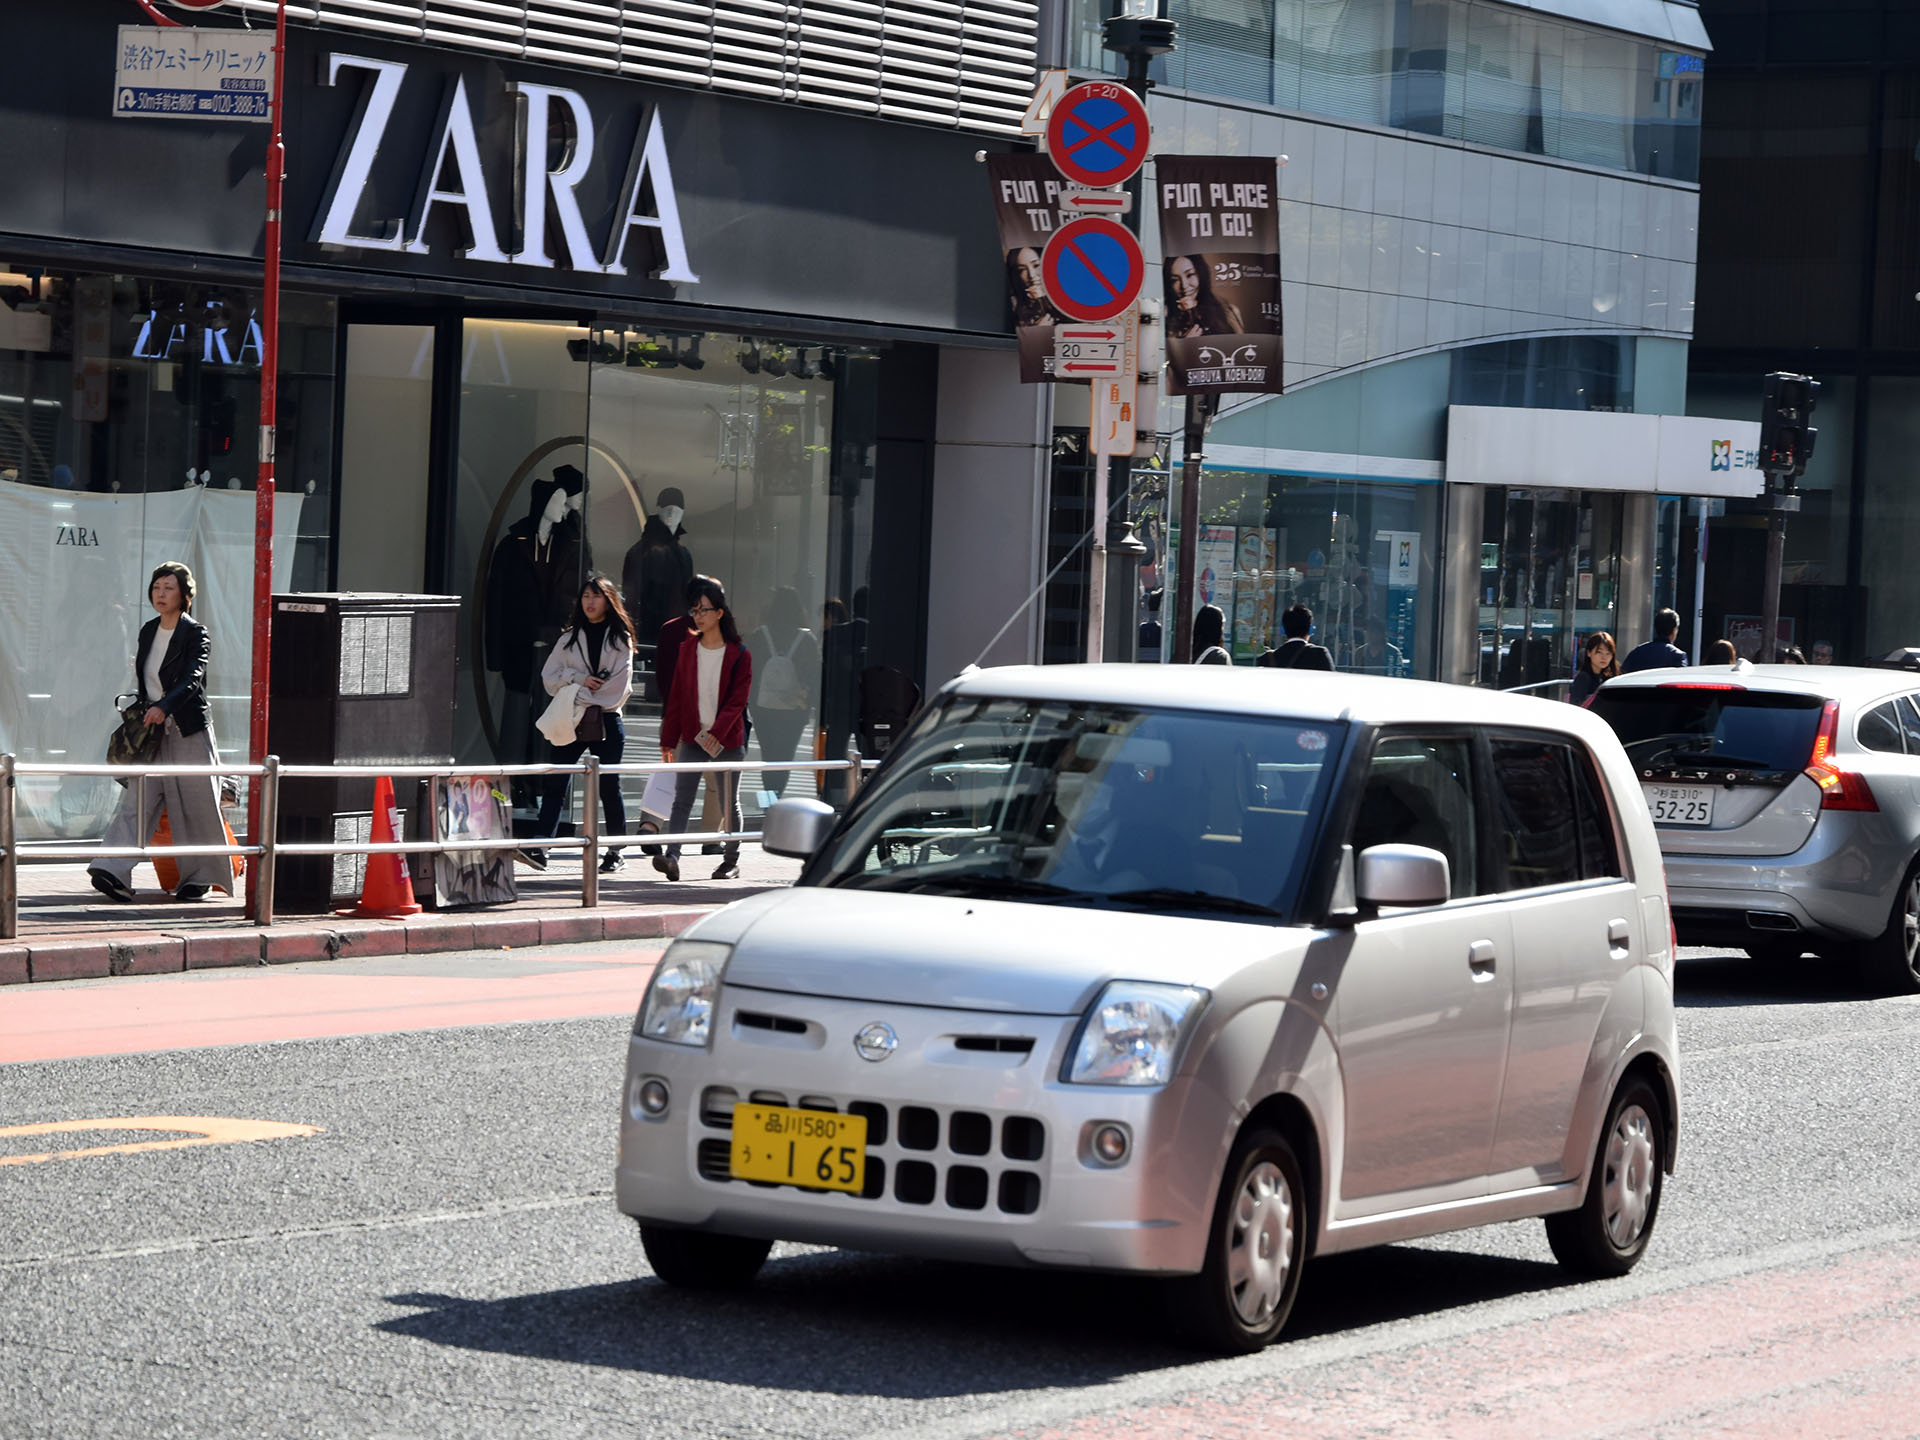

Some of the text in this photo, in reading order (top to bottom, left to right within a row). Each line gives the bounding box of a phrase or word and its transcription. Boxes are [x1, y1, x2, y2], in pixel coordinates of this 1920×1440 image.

[123, 44, 267, 74] 渋谷フェミークリニック
[1083, 85, 1119, 99] 7-20
[318, 51, 701, 284] ZARA
[1000, 180, 1039, 204] FUN
[1163, 183, 1269, 209] FUN PLACE
[1026, 208, 1053, 232] TO
[1186, 212, 1253, 237] TO GO!
[1214, 262, 1242, 281] 25
[1062, 344, 1081, 358] 20
[1108, 344, 1117, 359] 7
[1187, 367, 1265, 384] SHIBUYA KOEN-DORI
[56, 526, 99, 547] ZARA
[1643, 769, 1737, 781] OLVO
[1655, 801, 1709, 821] 52-25
